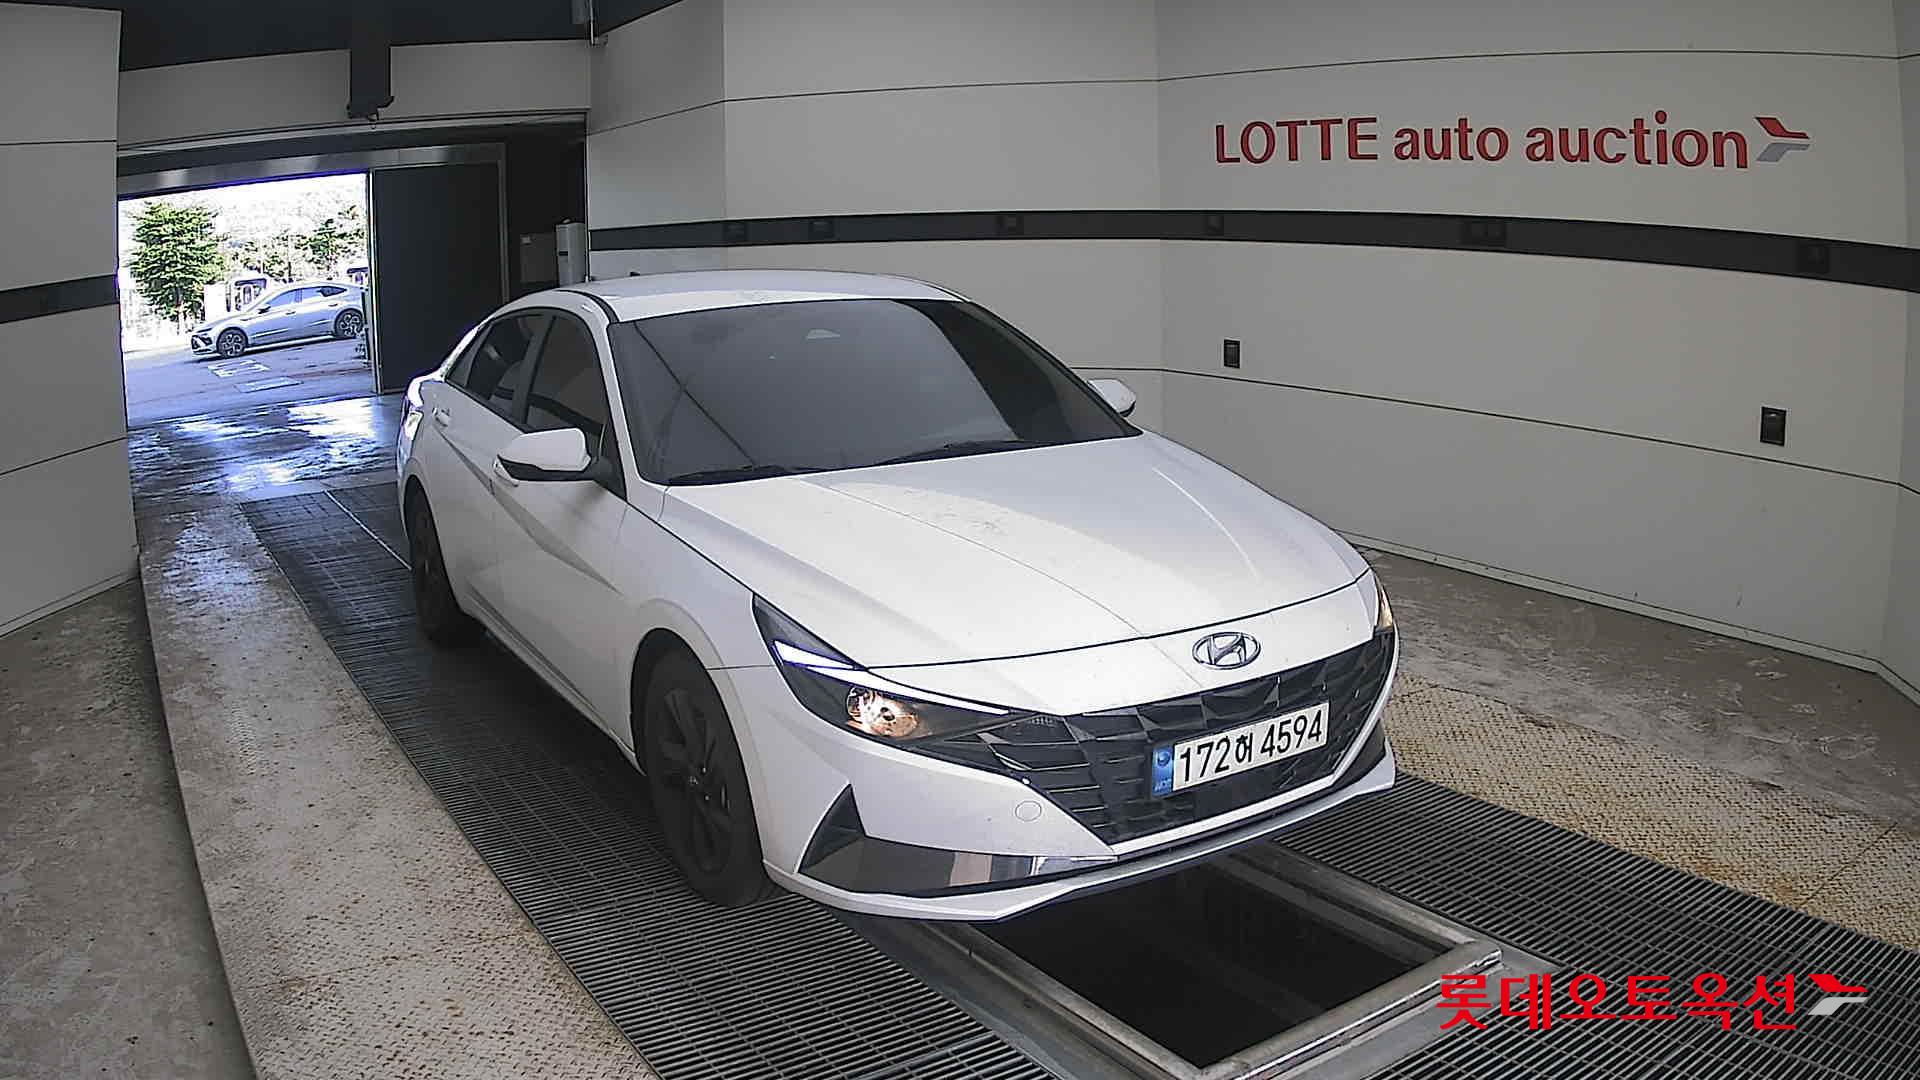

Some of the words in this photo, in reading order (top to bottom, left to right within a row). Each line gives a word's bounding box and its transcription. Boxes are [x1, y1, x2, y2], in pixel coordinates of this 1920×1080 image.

[1215, 117, 1378, 163] LOTTE
[1393, 117, 1509, 161] auto
[1525, 110, 1748, 168] auction
[1180, 732, 1253, 782] 172허
[1260, 710, 1322, 758] 4594
